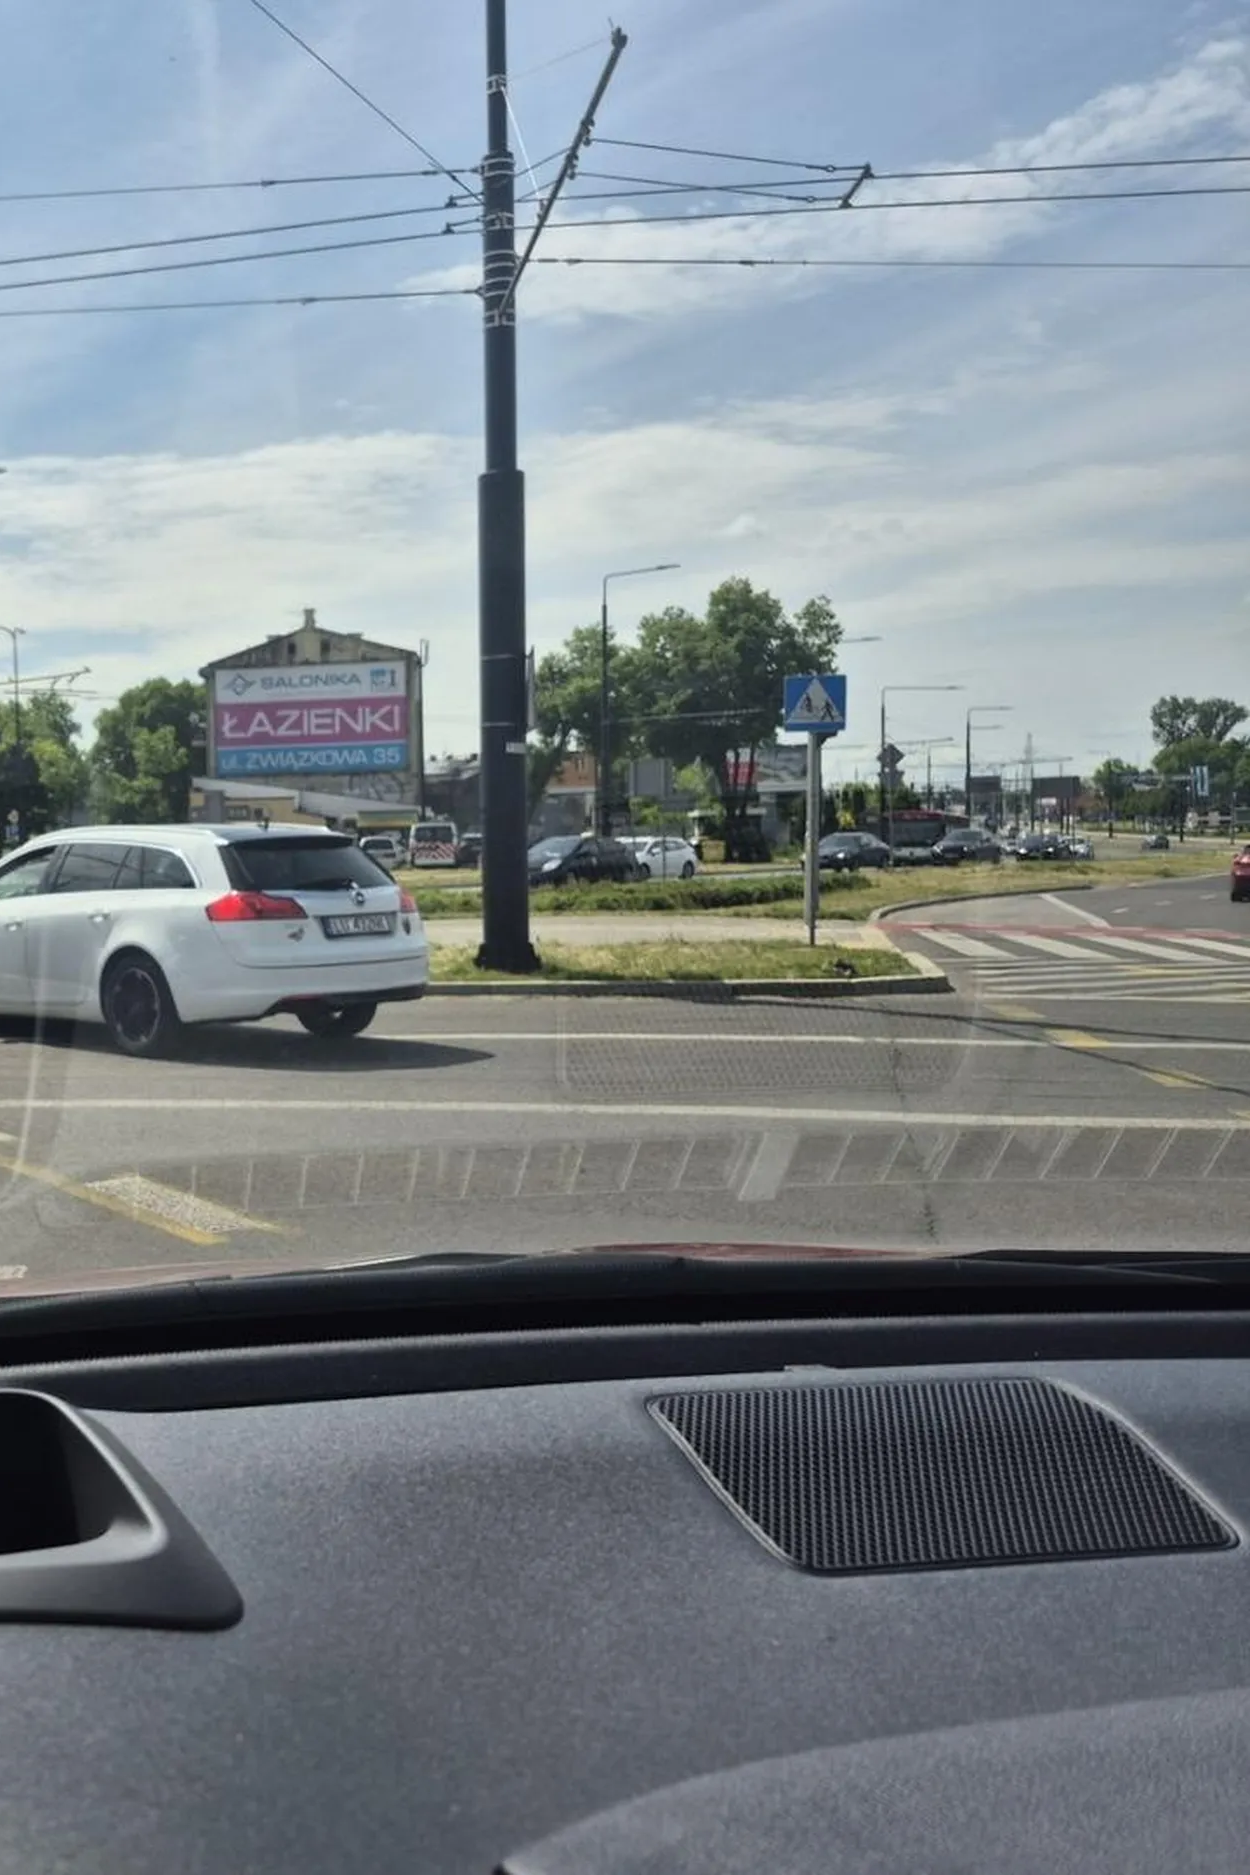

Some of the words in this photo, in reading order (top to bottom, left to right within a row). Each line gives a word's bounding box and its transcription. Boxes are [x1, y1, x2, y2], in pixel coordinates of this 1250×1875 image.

[260, 673, 361, 690] SALONIKA
[221, 704, 401, 739] ŁAZIENKI
[248, 749, 368, 771] ZWIĄZKOWA
[373, 747, 400, 765] 35
